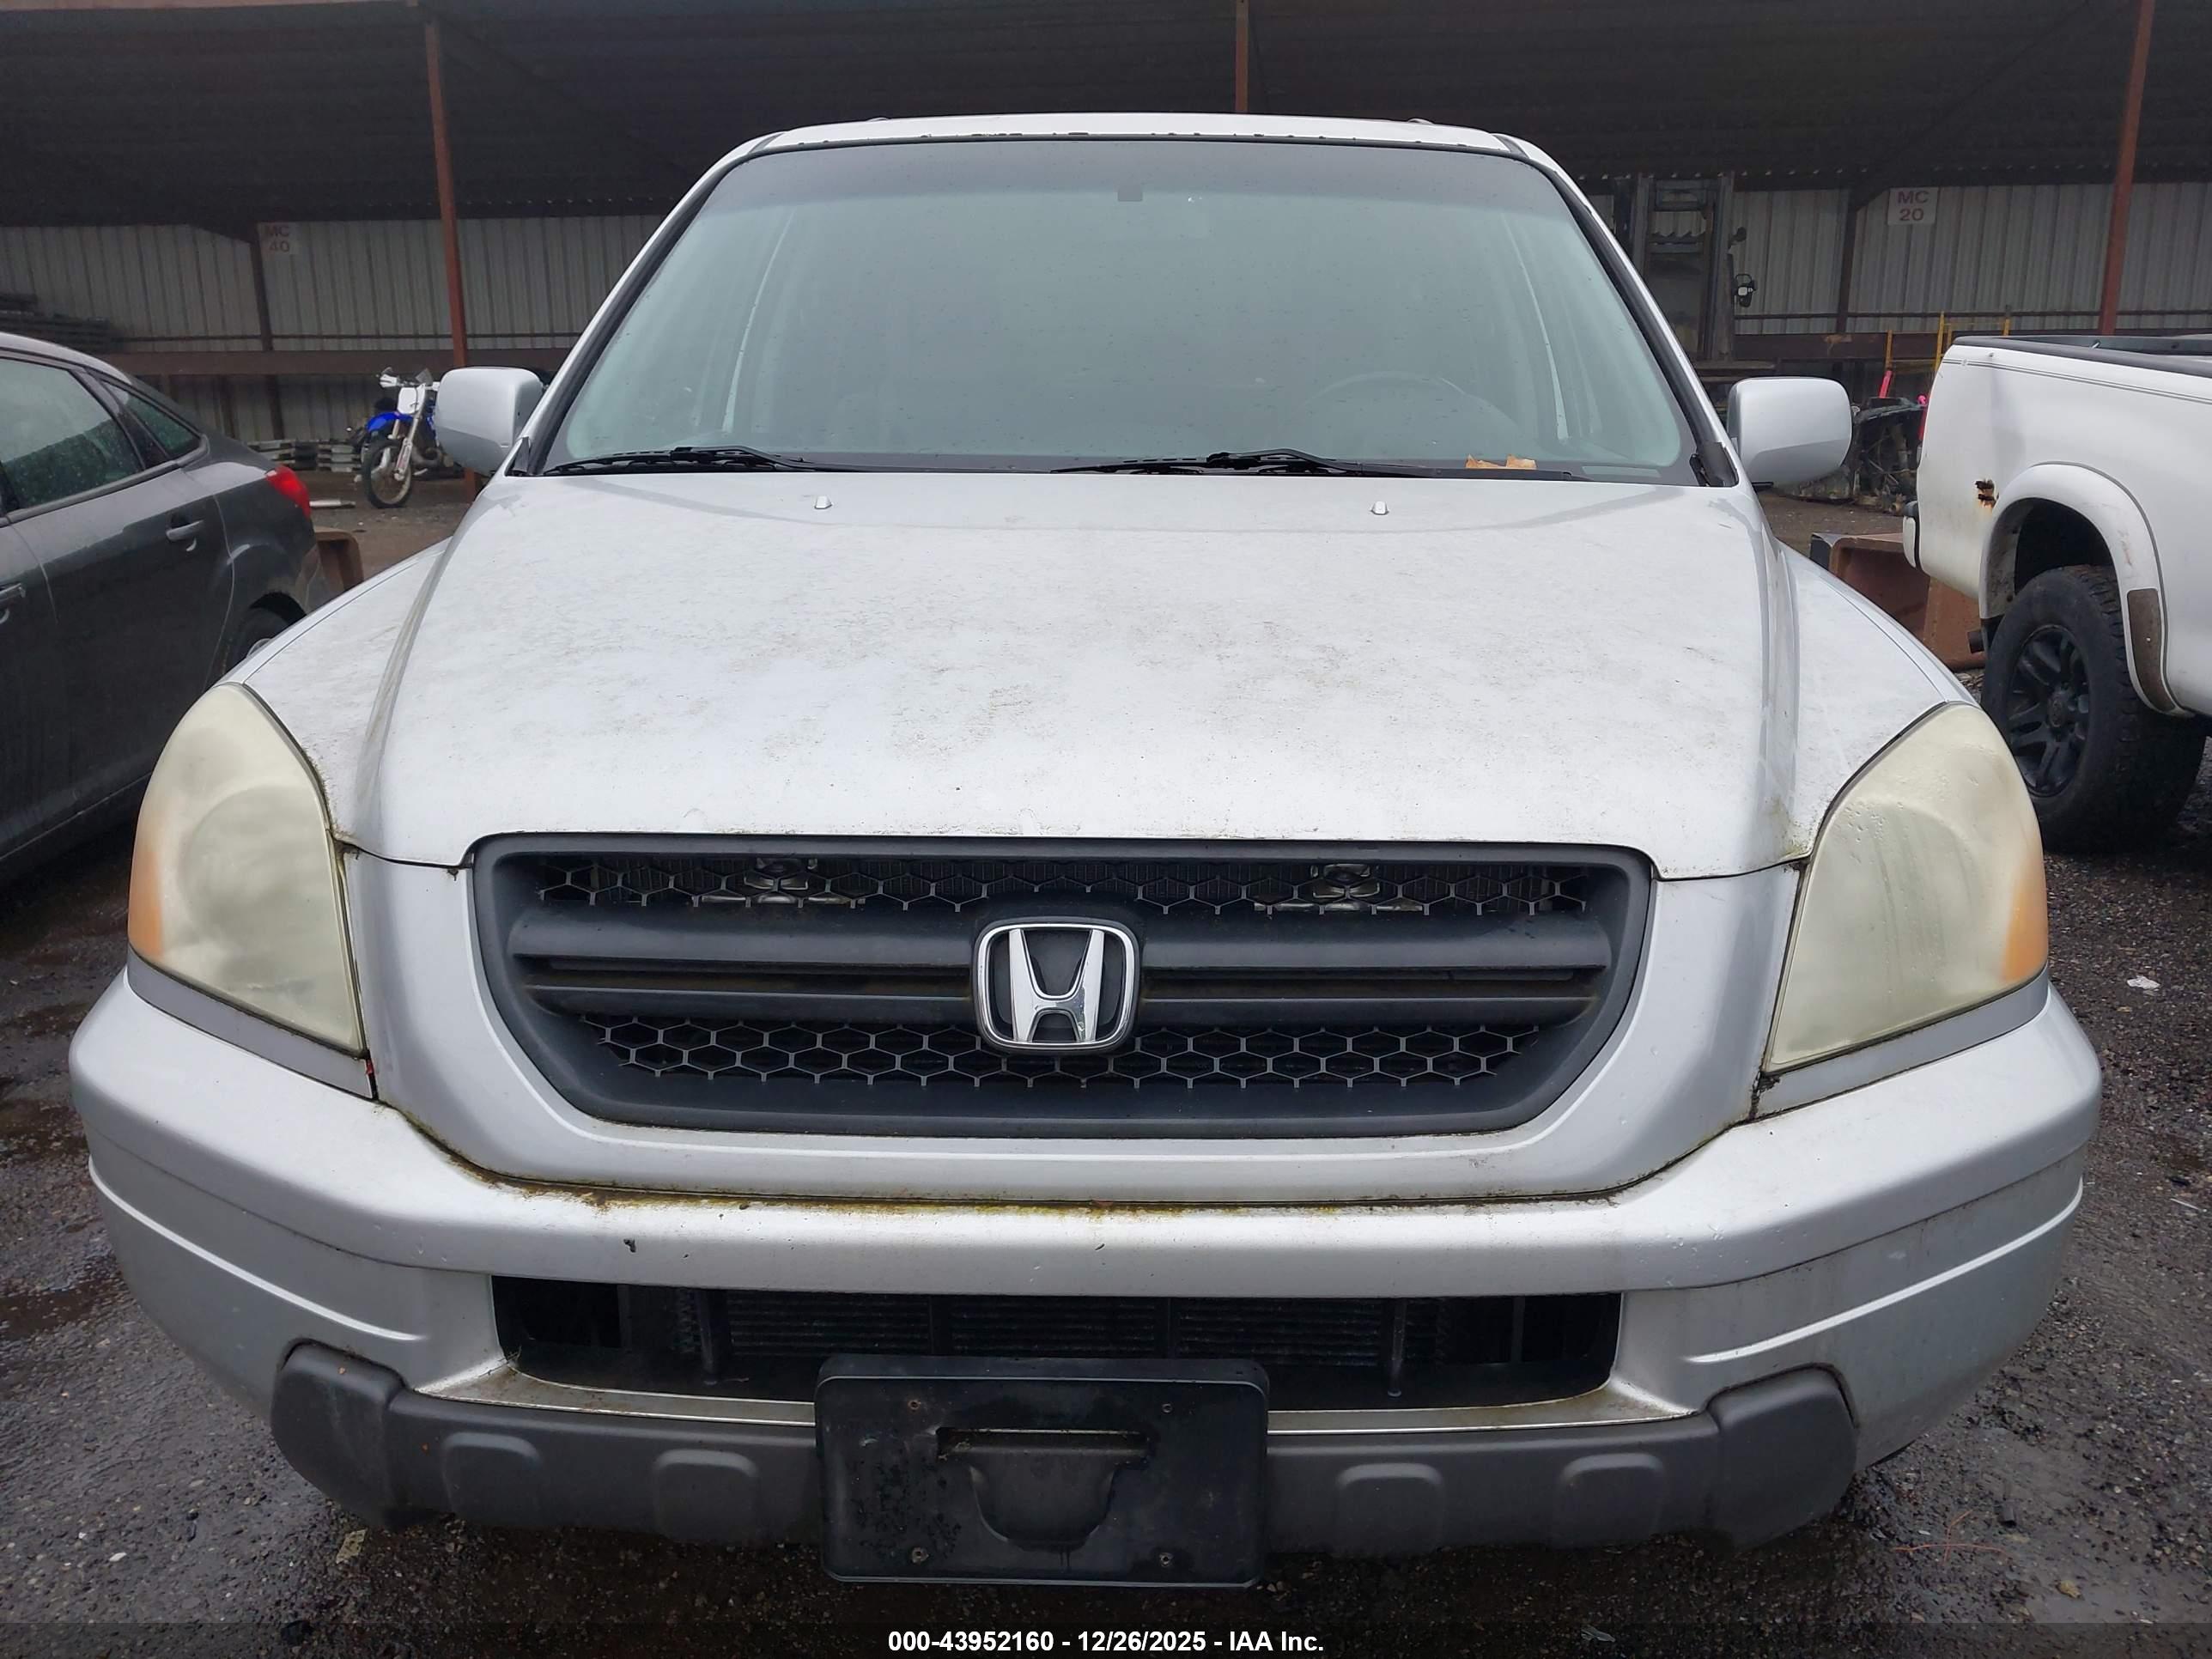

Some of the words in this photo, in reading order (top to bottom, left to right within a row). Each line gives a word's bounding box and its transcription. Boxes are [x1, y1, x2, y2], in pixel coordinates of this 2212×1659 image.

[1898, 191, 1929, 204] MC
[1899, 208, 1924, 221] 20
[264, 225, 290, 237] MC
[268, 240, 290, 252] 40
